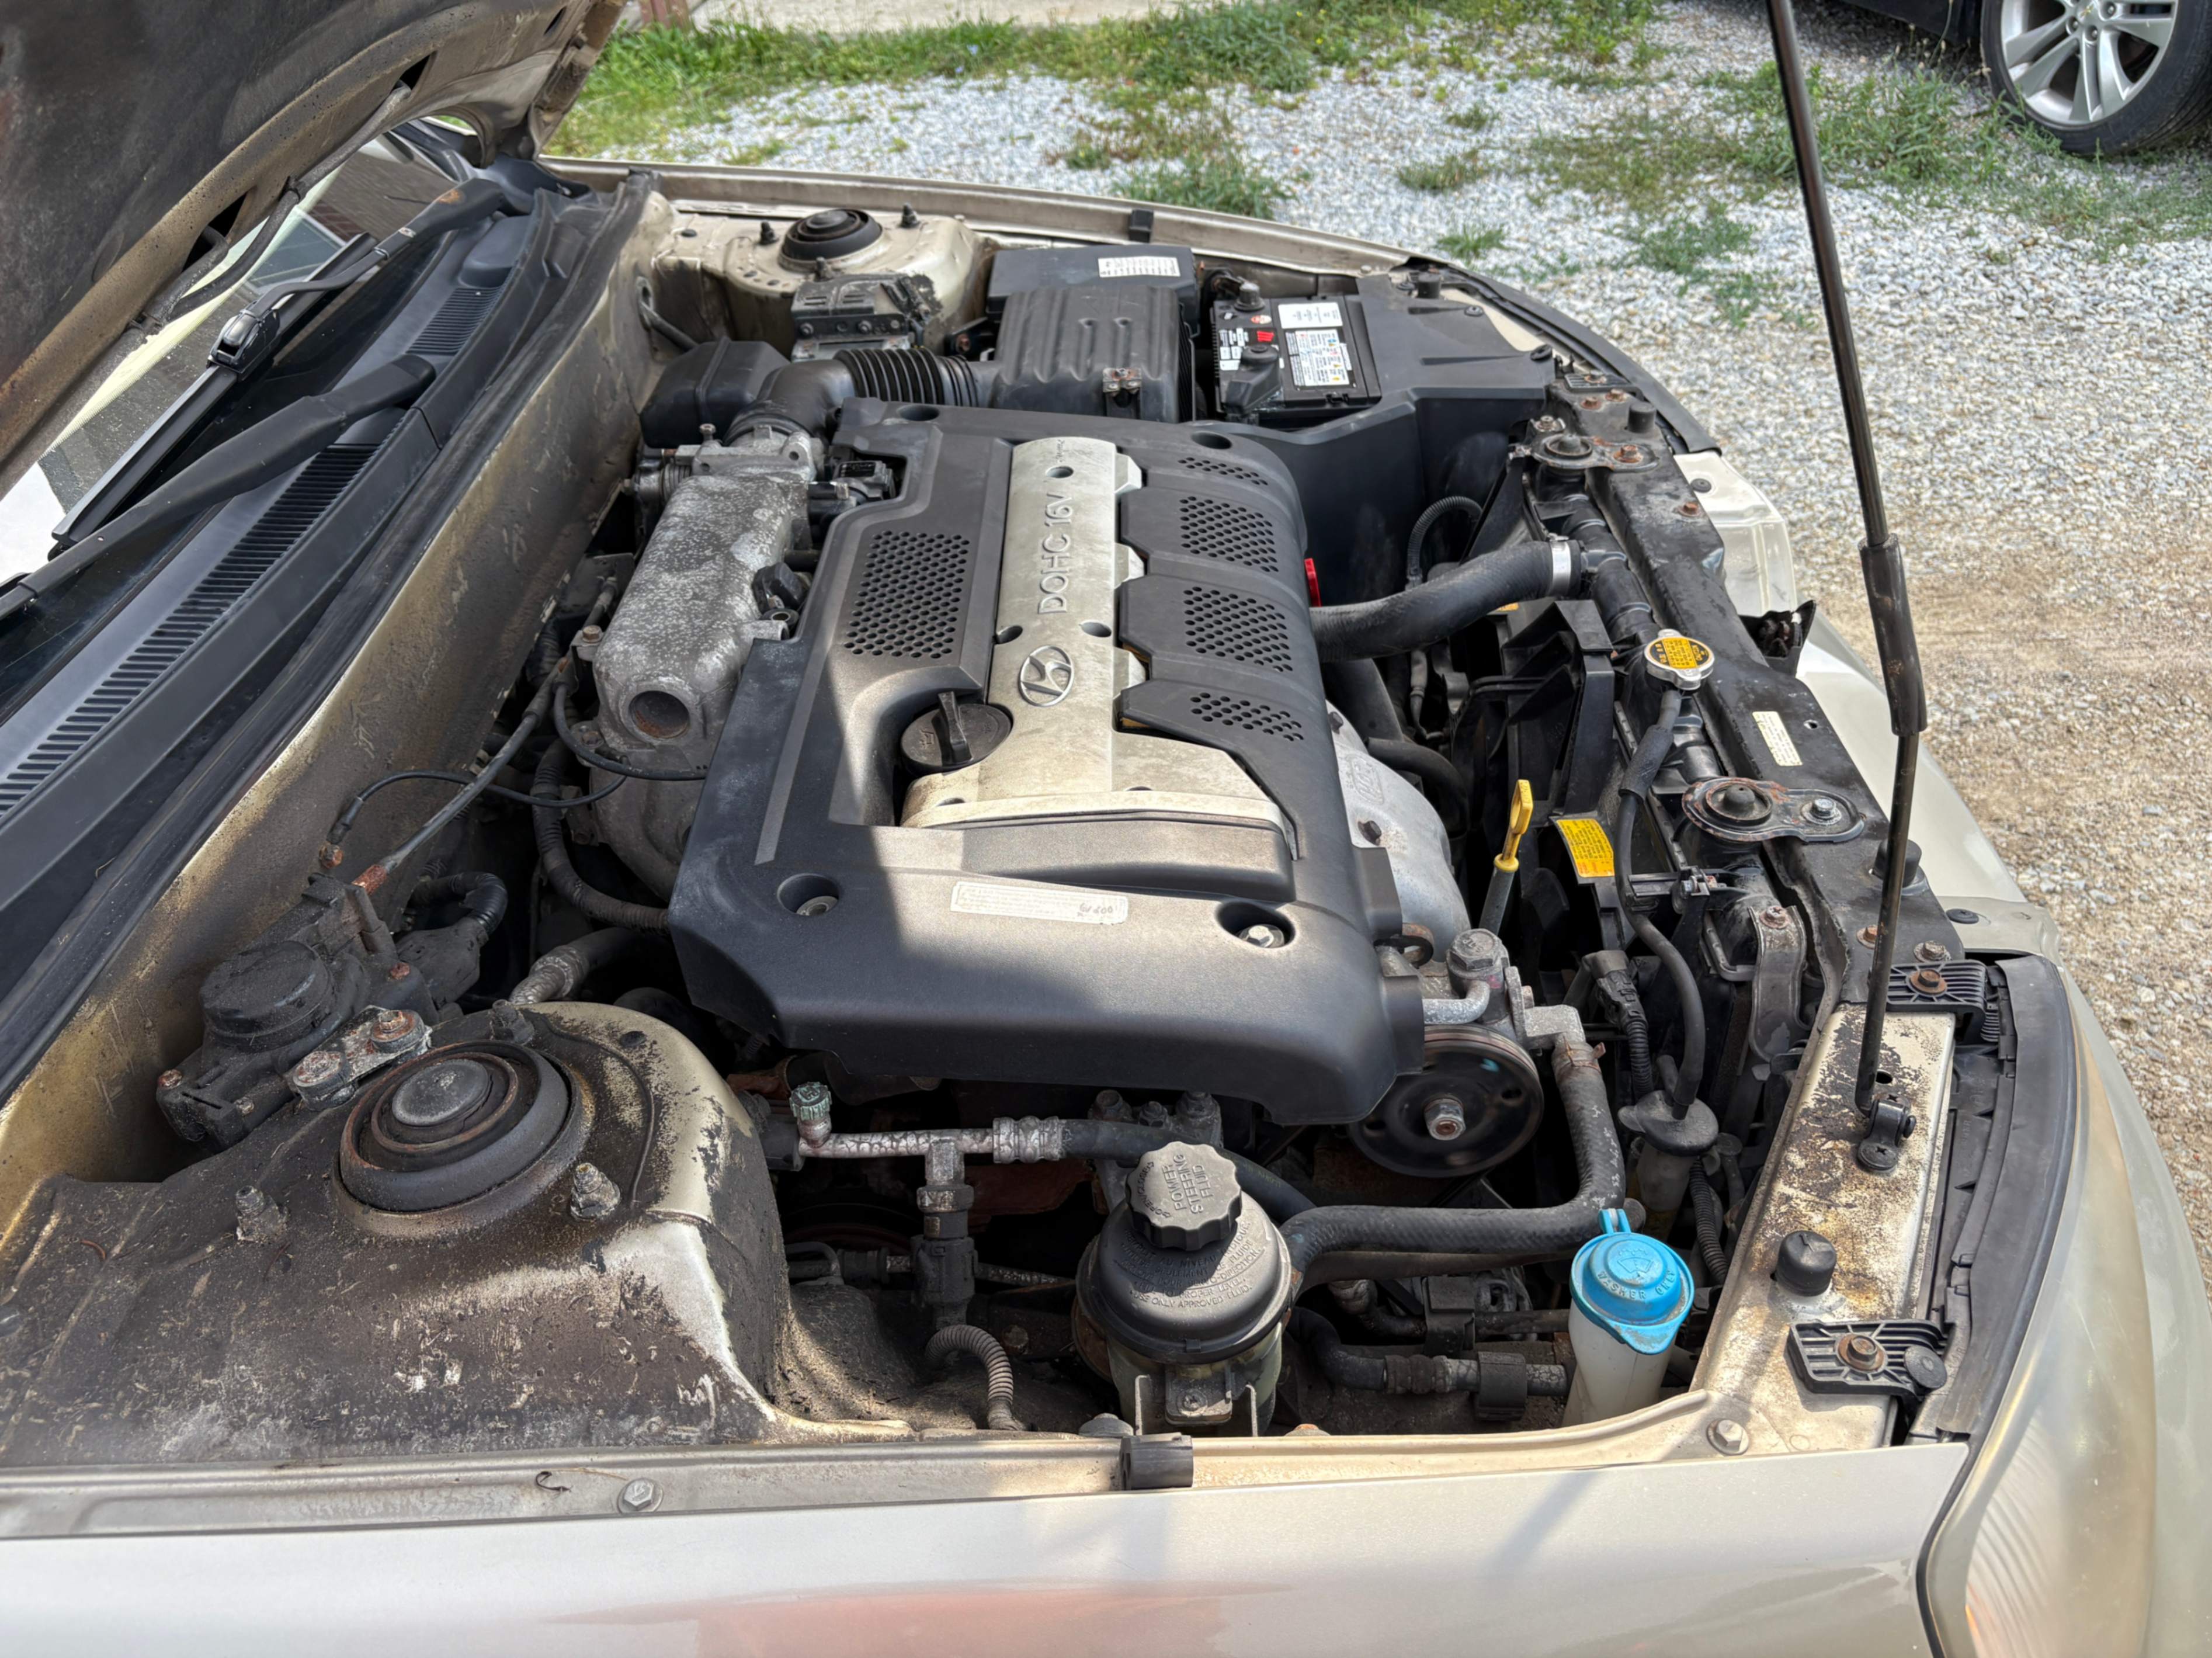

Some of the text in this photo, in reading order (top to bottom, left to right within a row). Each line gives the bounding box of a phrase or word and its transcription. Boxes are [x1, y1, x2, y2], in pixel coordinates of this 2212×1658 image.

[1037, 492, 1072, 614] DOHC 16V
[1162, 1164, 1187, 1210] POWER
[1173, 1154, 1204, 1214] STEERING
[1192, 1165, 1214, 1198] FLUID
[1229, 1239, 1254, 1263] FLUIDE
[1179, 1287, 1214, 1299] PROPER
[1598, 1270, 1675, 1300] WASHER ONLY
[1151, 1296, 1175, 1307] ONLY
[1178, 1295, 1224, 1308] APPROVED
